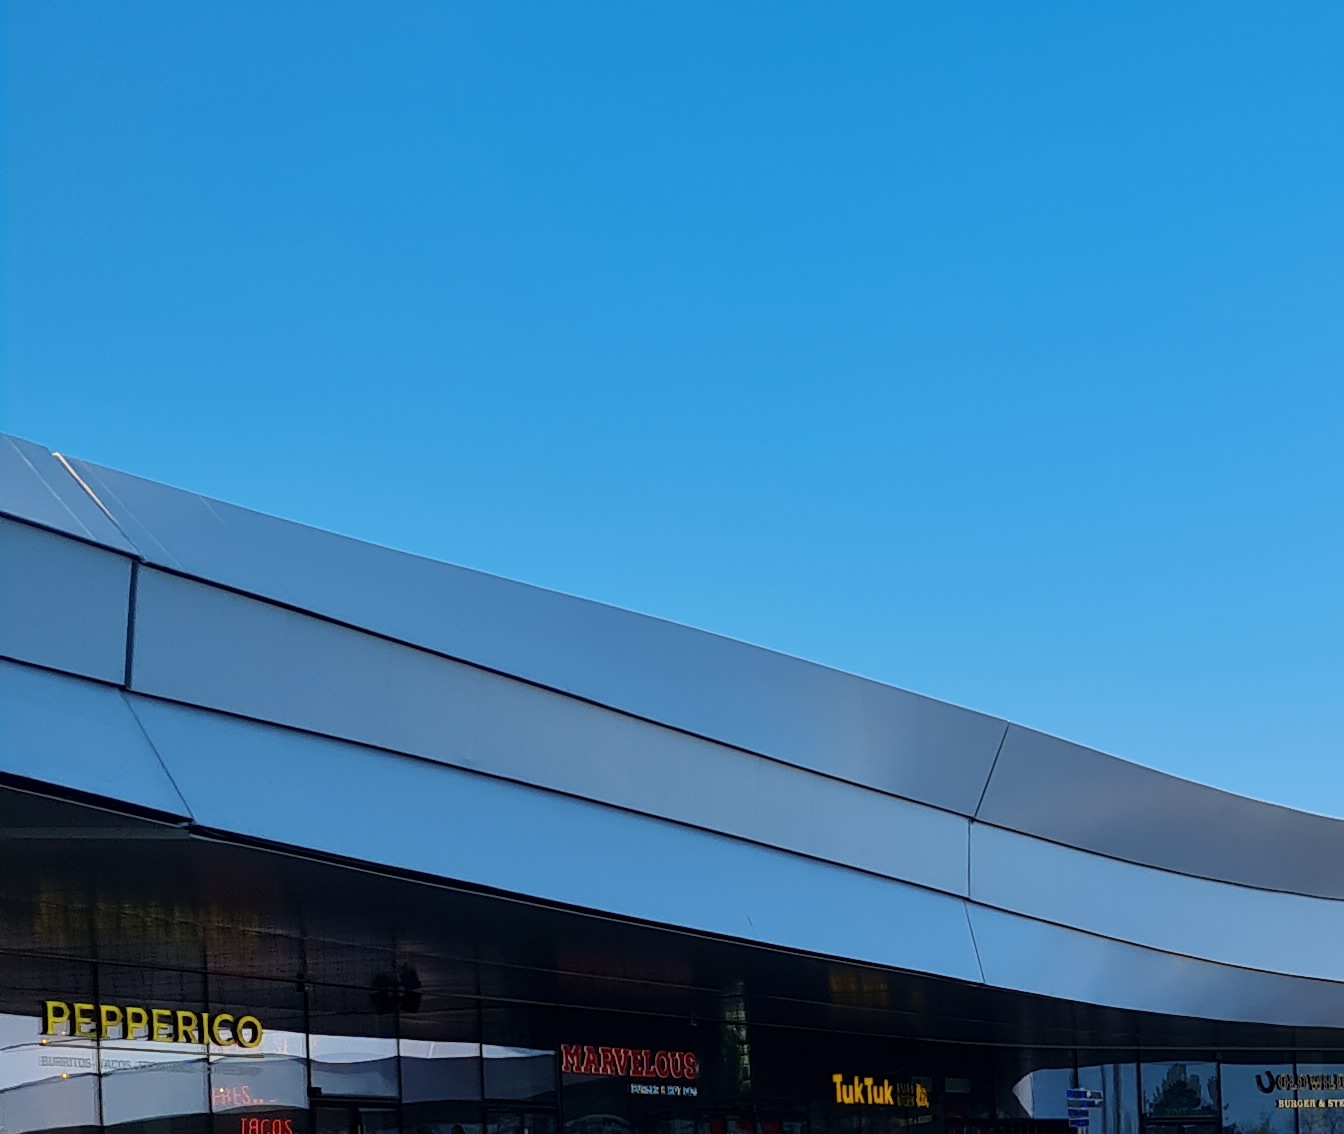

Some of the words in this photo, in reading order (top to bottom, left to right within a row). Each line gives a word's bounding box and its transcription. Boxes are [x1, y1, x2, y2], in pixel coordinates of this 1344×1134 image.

[44, 1000, 264, 1049] PEPPERICO
[561, 1043, 697, 1080] MARVELOUS
[832, 1073, 895, 1106] TukTuk
[1277, 1099, 1316, 1109] BURGER
